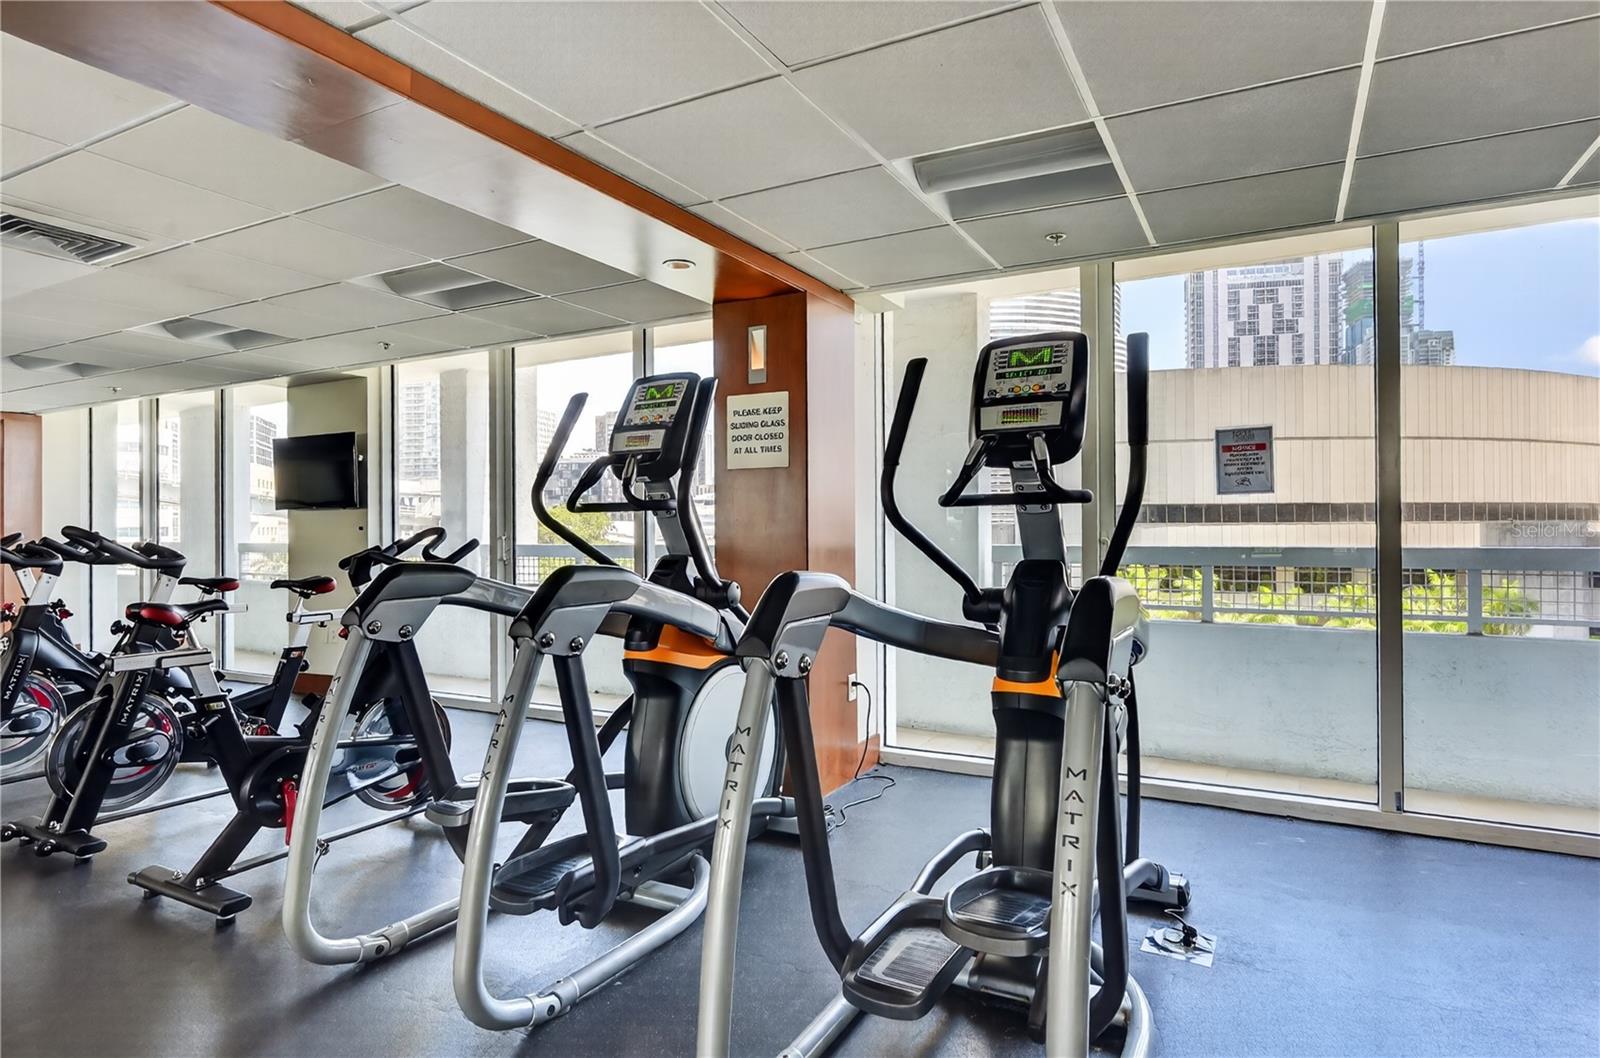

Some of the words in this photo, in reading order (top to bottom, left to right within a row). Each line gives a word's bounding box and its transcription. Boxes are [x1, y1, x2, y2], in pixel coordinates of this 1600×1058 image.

[730, 421, 759, 430] SLIDING
[760, 419, 786, 428] GLASS
[733, 408, 760, 417] PLEASE
[763, 406, 782, 415] KEEP
[731, 433, 753, 442] DOOR
[754, 432, 784, 441] CLOSED
[733, 447, 742, 455] AT
[744, 446, 758, 454] ALL
[760, 445, 782, 453] TIMES
[3, 656, 27, 700] MATRIX
[121, 674, 144, 723] MATRIX
[480, 694, 515, 781] MATRIX
[720, 726, 752, 830] MATRIX
[1060, 766, 1088, 897] MATRIX
